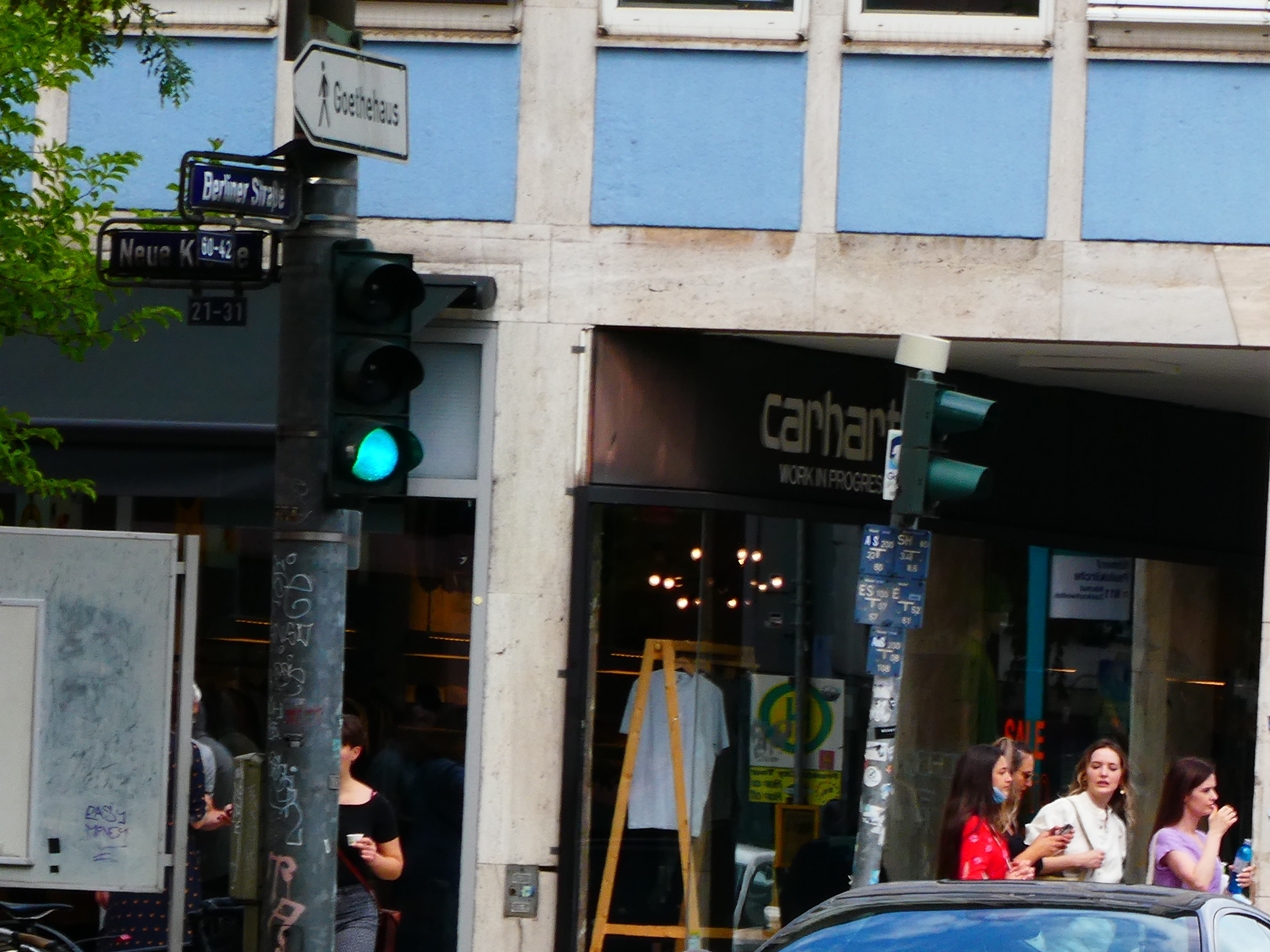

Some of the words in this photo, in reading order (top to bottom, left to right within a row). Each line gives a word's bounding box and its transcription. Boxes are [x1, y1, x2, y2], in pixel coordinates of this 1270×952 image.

[333, 81, 399, 127] Goethehaus
[202, 171, 250, 206] Berliner
[251, 177, 286, 213] Straße
[119, 238, 171, 267] Neue
[201, 236, 234, 261] 60-42
[192, 302, 243, 322] 21-31
[760, 390, 902, 462] carhart
[780, 463, 812, 487] WORK
[829, 469, 883, 495] PROGRES
[858, 584, 874, 597] ES
